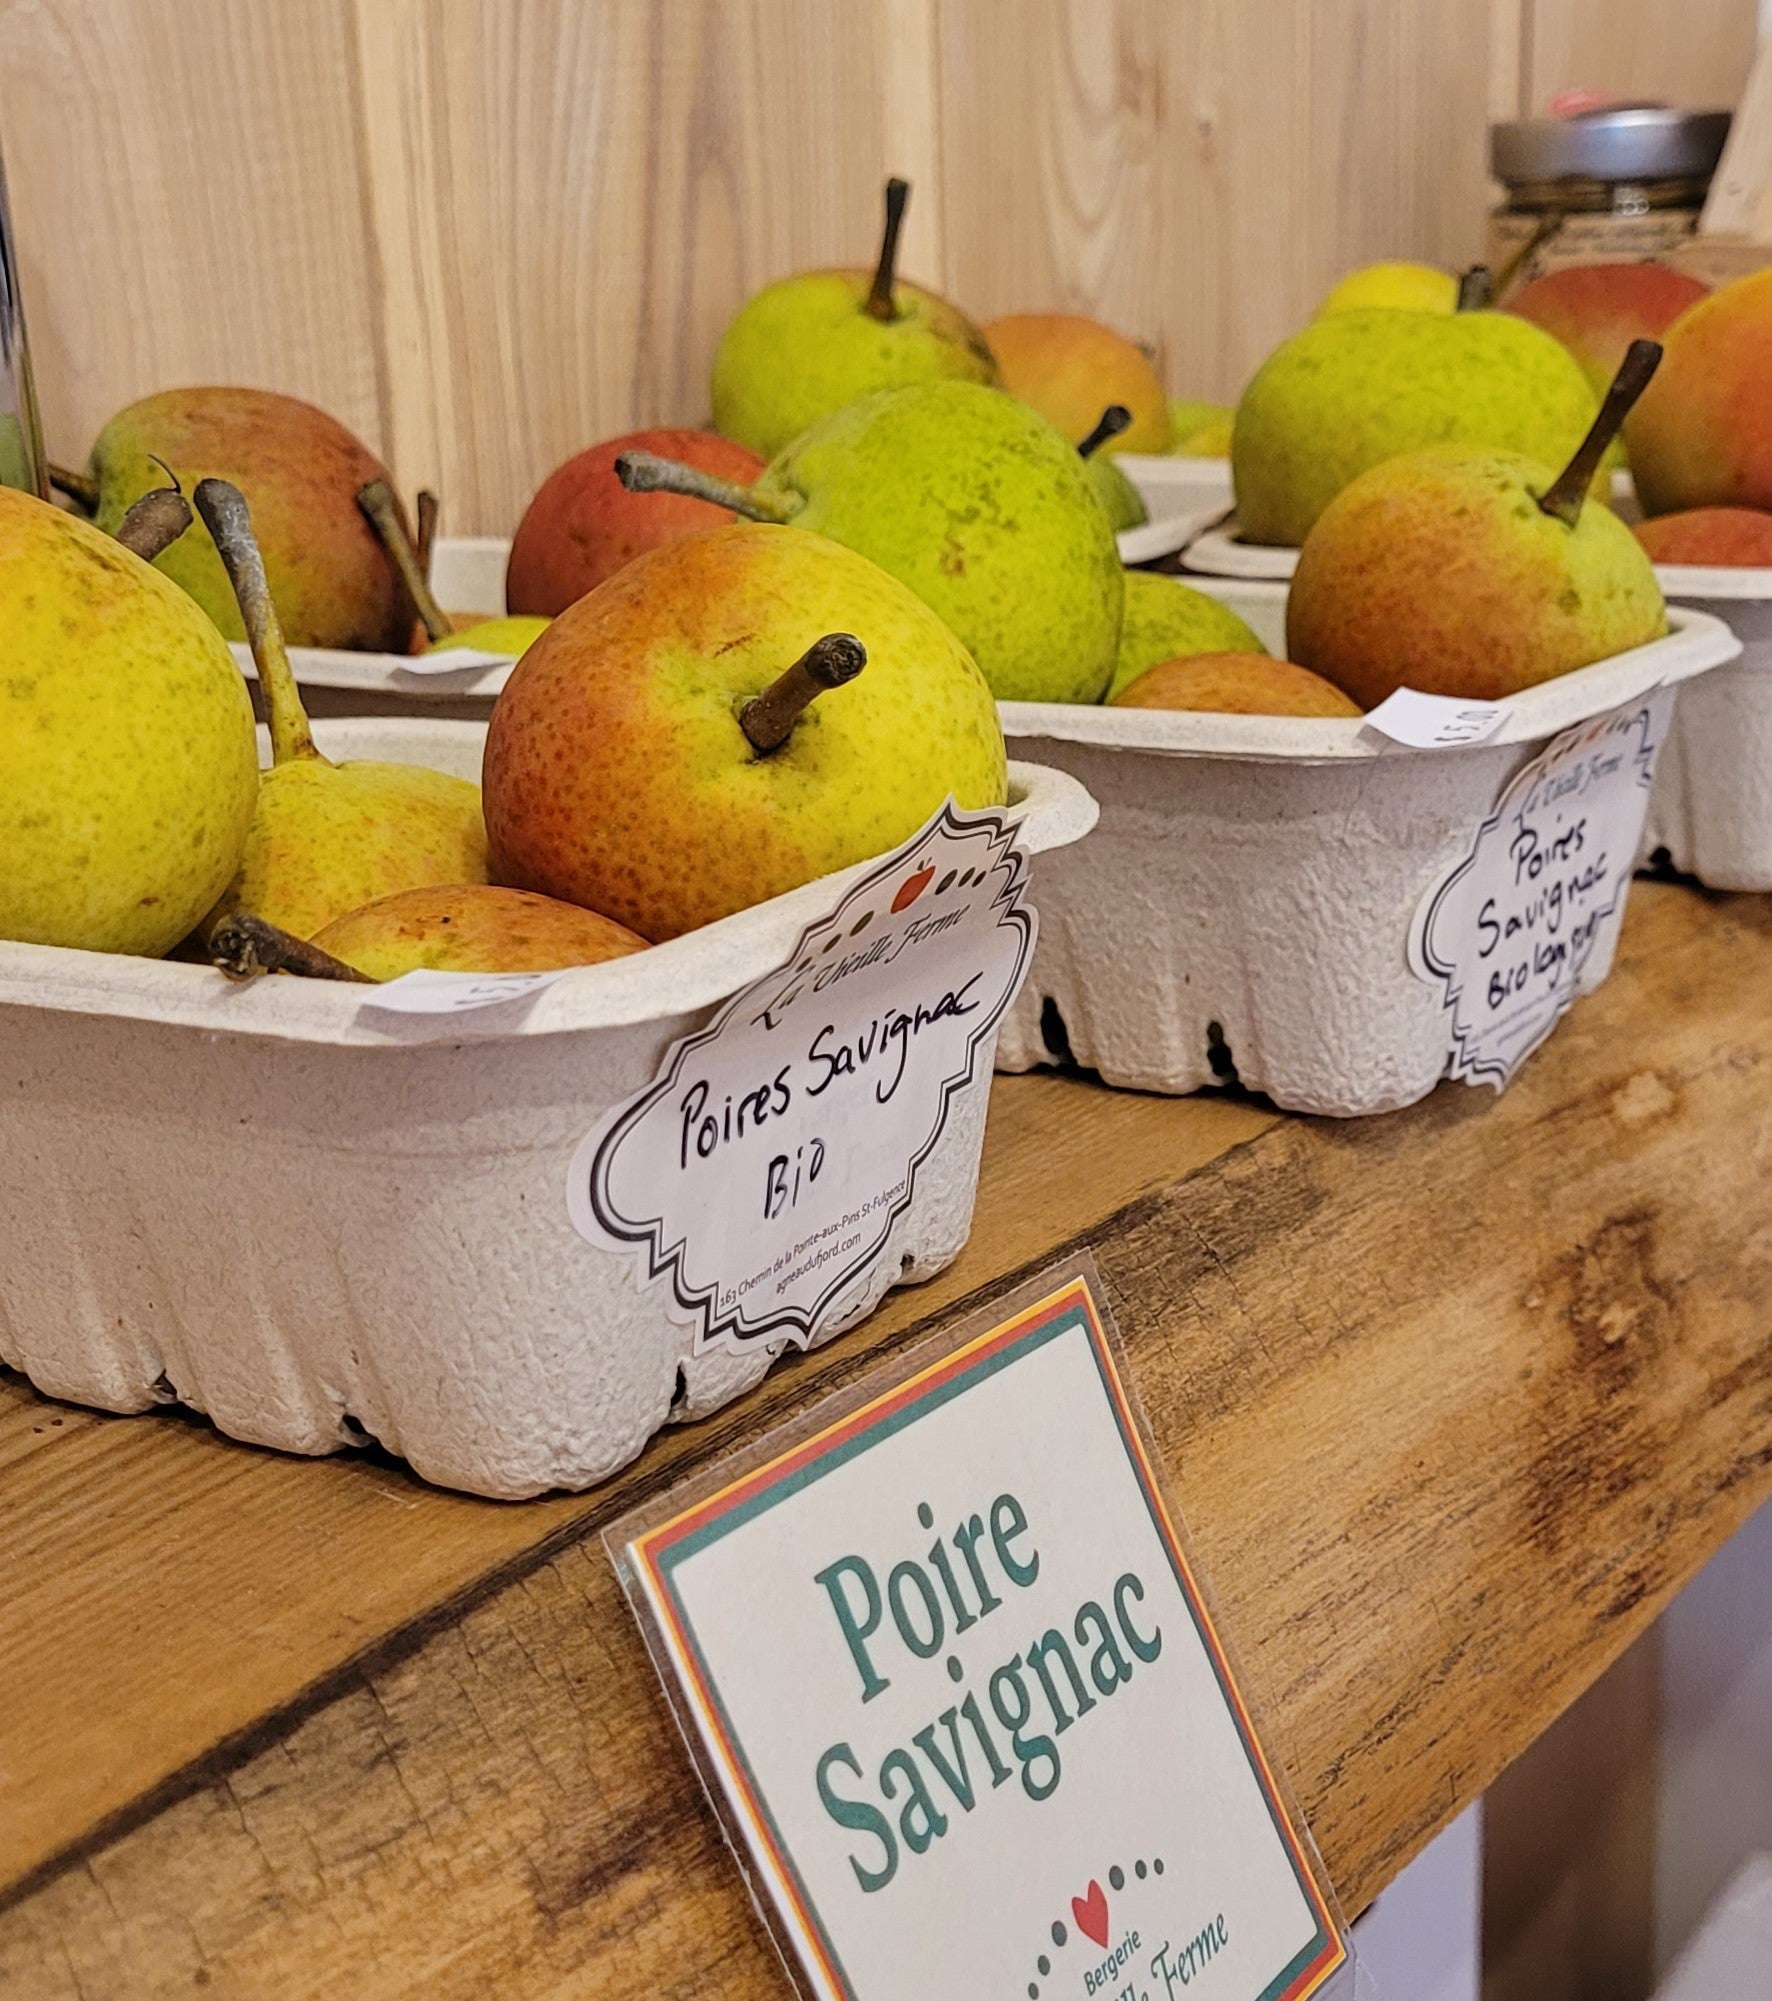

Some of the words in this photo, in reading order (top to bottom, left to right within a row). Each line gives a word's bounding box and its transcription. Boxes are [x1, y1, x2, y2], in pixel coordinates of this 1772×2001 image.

[1510, 814, 1587, 887] Poires
[1477, 852, 1607, 958] Savignac
[750, 964, 816, 1031] La
[813, 933, 893, 993] Vieille
[884, 903, 971, 964] Ferme
[680, 1064, 791, 1169] Poires
[805, 971, 984, 1103] Savignac
[764, 1137, 824, 1220] Bio
[719, 1290, 737, 1308] 163
[738, 1265, 772, 1296] Chemin
[773, 1258, 783, 1273] de
[785, 1253, 793, 1266] la
[793, 1210, 860, 1259] Pointe-aux-Pins
[861, 1179, 907, 1218] St-Fulgence
[775, 1232, 862, 1295] agneaudufjord.com
[813, 1493, 1040, 1703] Poire
[815, 1572, 1162, 1893] Savignac
[1083, 1930, 1142, 1998] Bergerie
[1150, 1913, 1229, 2001] Ferme
